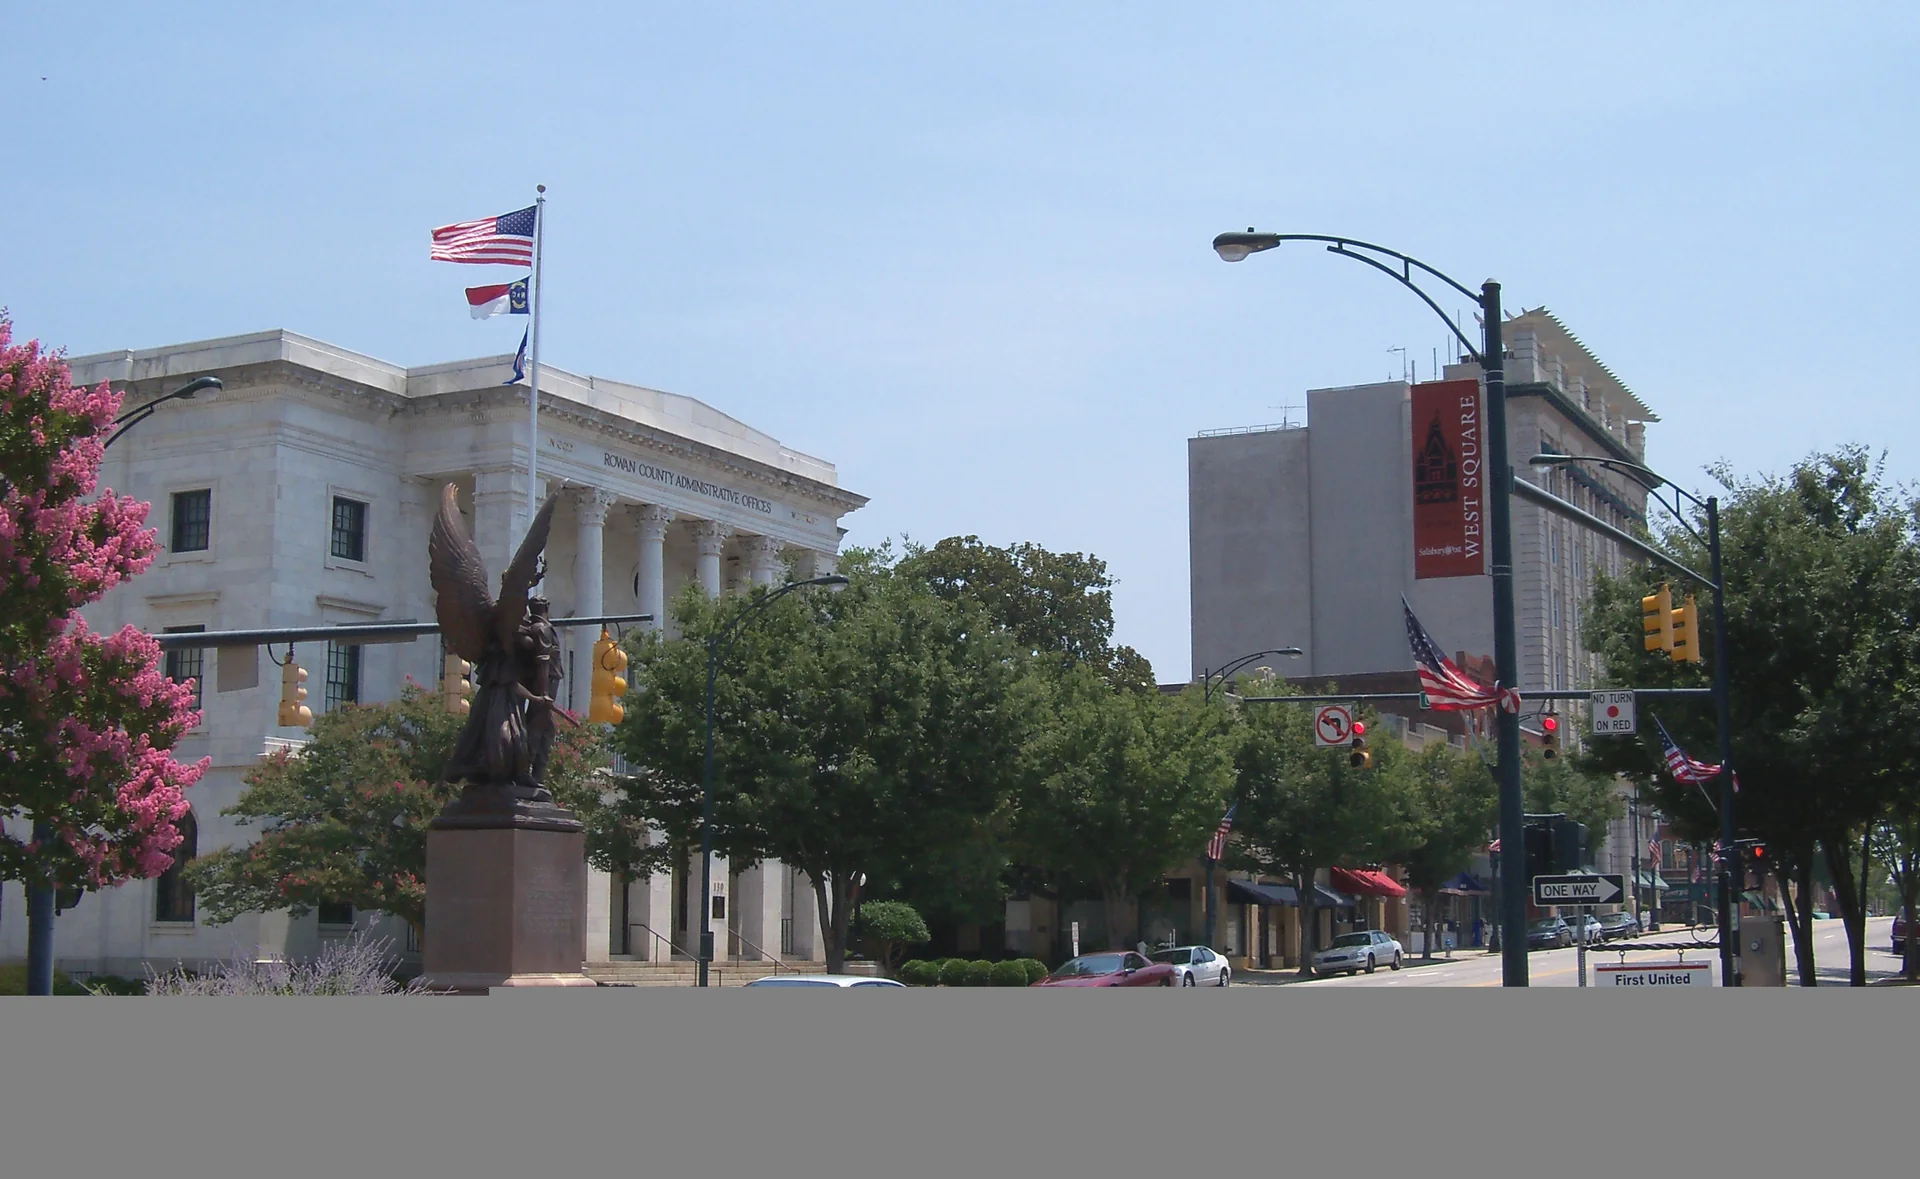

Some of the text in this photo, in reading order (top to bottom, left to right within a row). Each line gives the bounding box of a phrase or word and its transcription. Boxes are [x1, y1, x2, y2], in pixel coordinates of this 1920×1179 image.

[604, 452, 772, 514] ROWAN COUNTY ADMINISTRATIVE OFFICES
[1460, 395, 1480, 559] WEST SQUARE
[1593, 693, 1632, 704] NO TURN
[1596, 720, 1631, 731] ON RED
[1544, 884, 1597, 897] ONE WAY
[1615, 972, 1691, 986] First United
